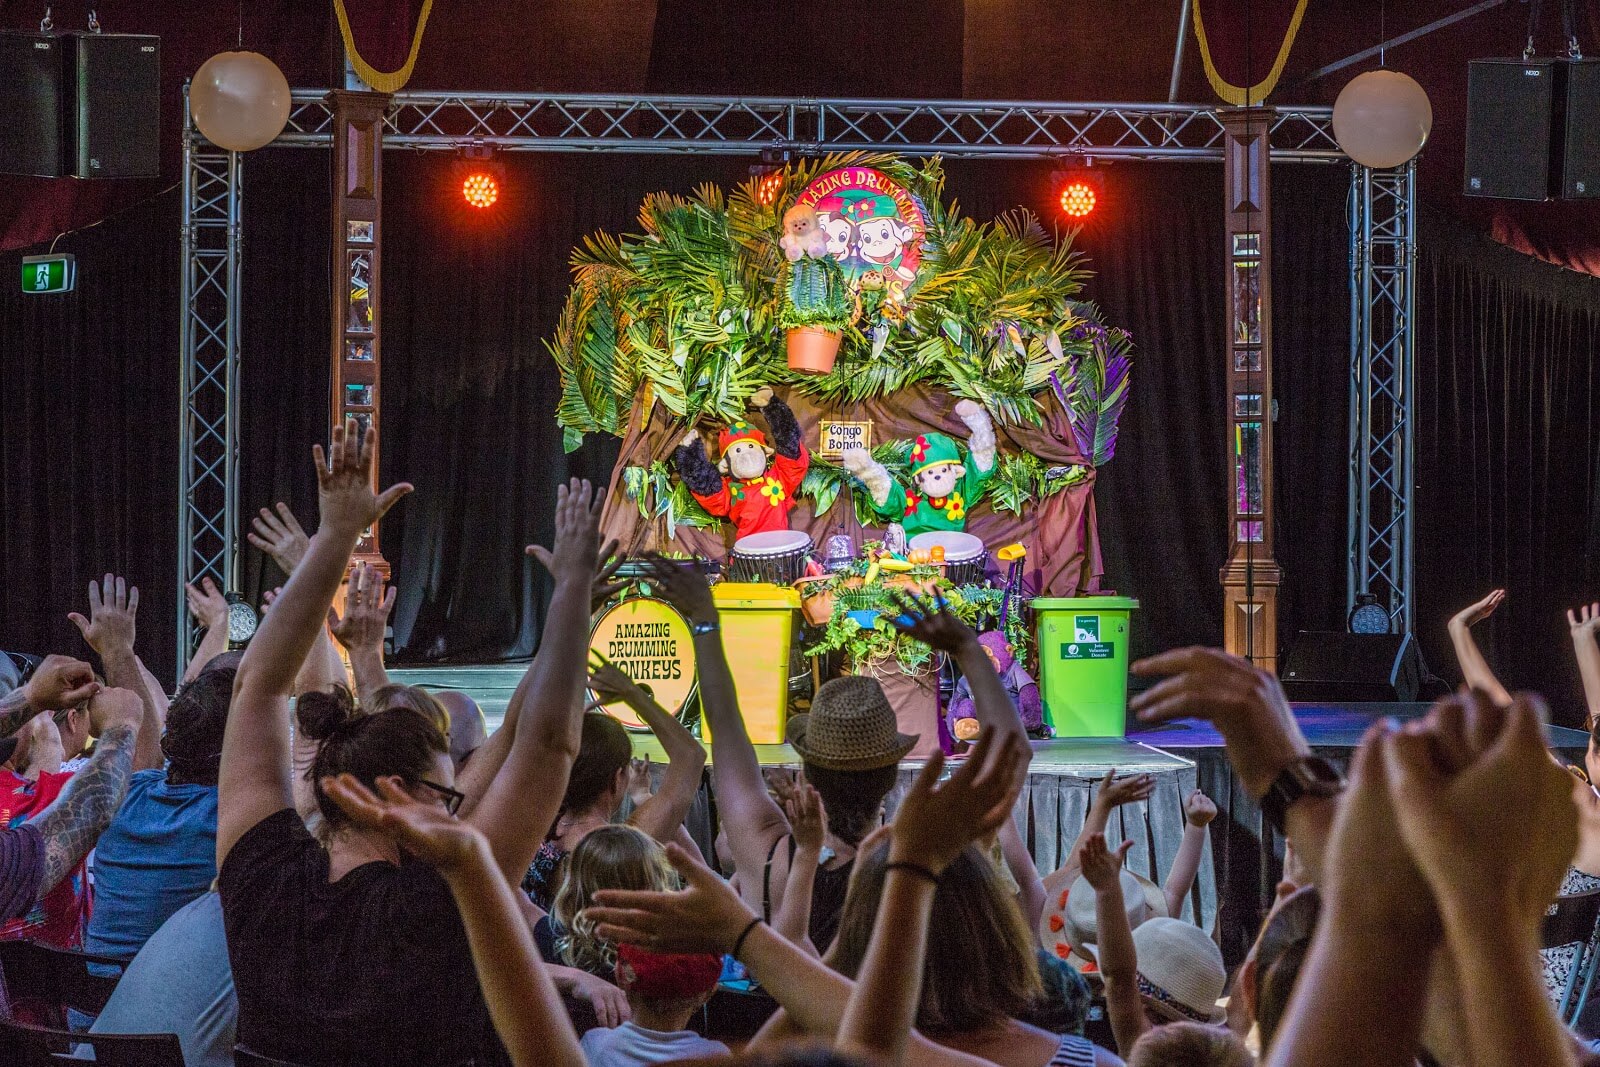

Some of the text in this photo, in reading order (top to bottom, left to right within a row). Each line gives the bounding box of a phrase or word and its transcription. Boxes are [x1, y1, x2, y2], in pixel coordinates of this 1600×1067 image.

[830, 424, 862, 439] Congo
[615, 623, 670, 638] AMAZING
[608, 640, 677, 658] DRUMMING
